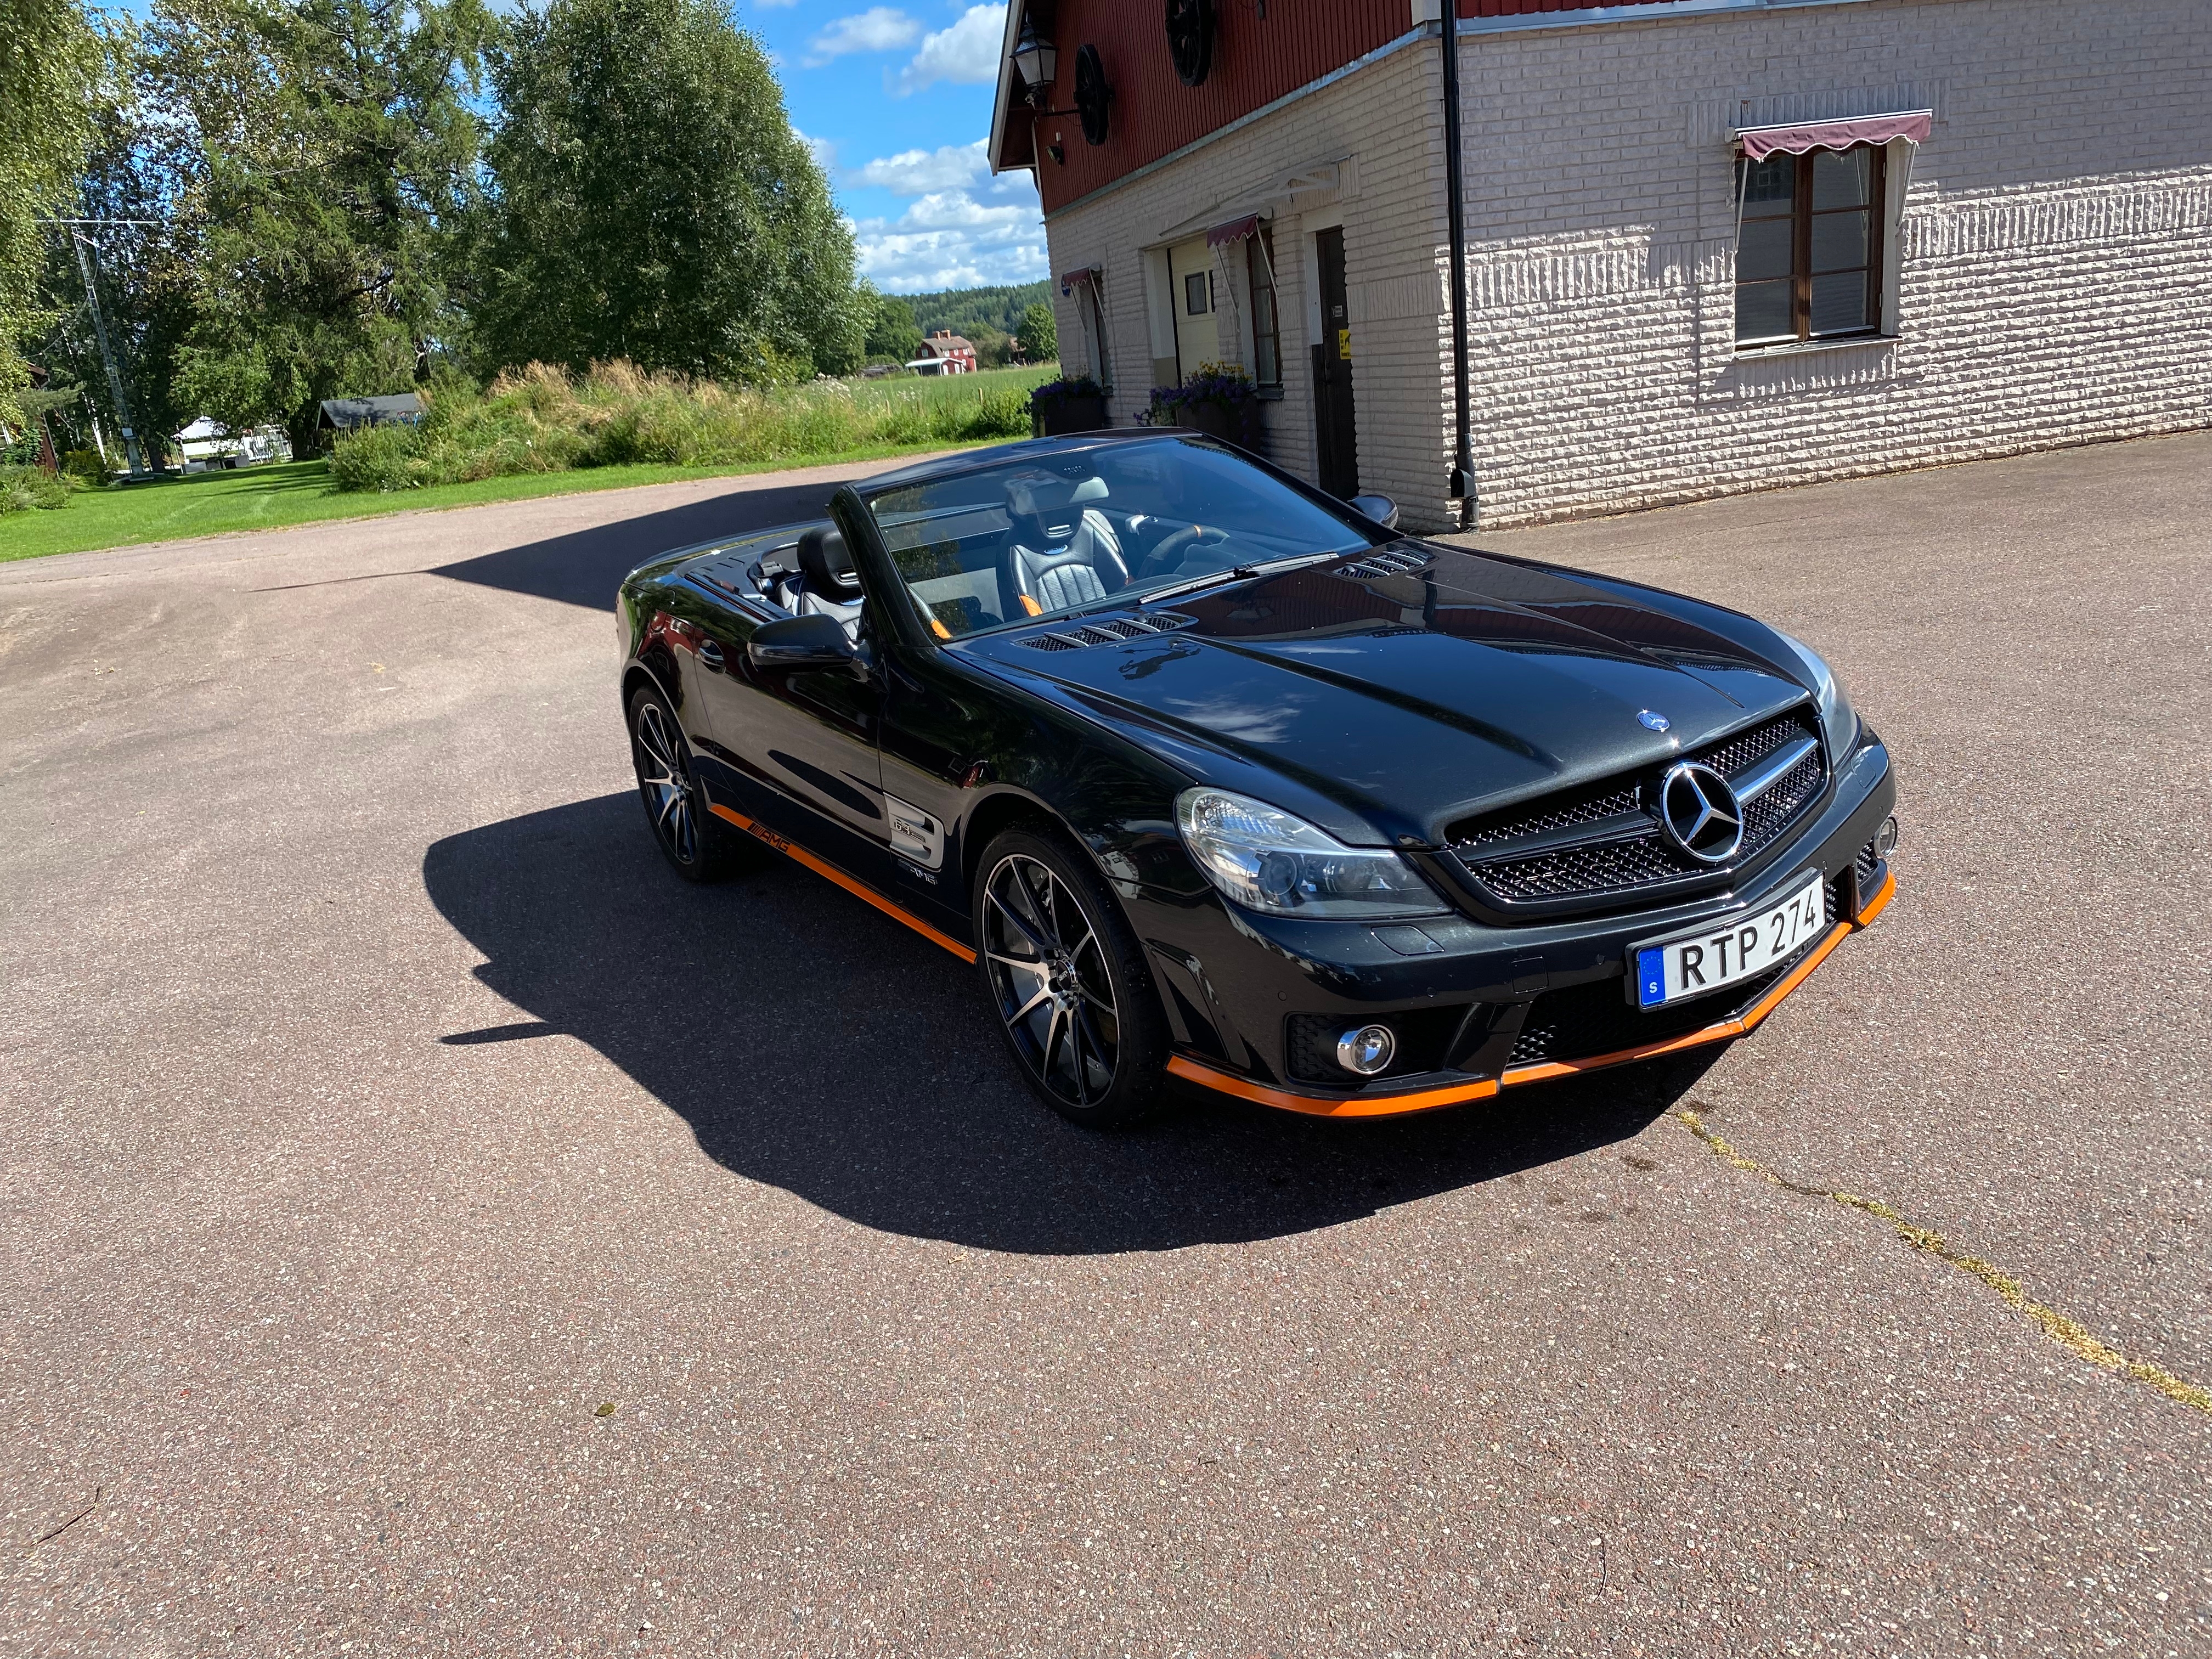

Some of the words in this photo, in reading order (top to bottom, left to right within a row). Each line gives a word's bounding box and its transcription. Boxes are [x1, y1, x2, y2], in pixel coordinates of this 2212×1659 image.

[759, 829, 790, 853] AMG
[1680, 926, 1758, 990] RTP
[1770, 889, 1816, 956] 274
[1649, 981, 1658, 994] S
